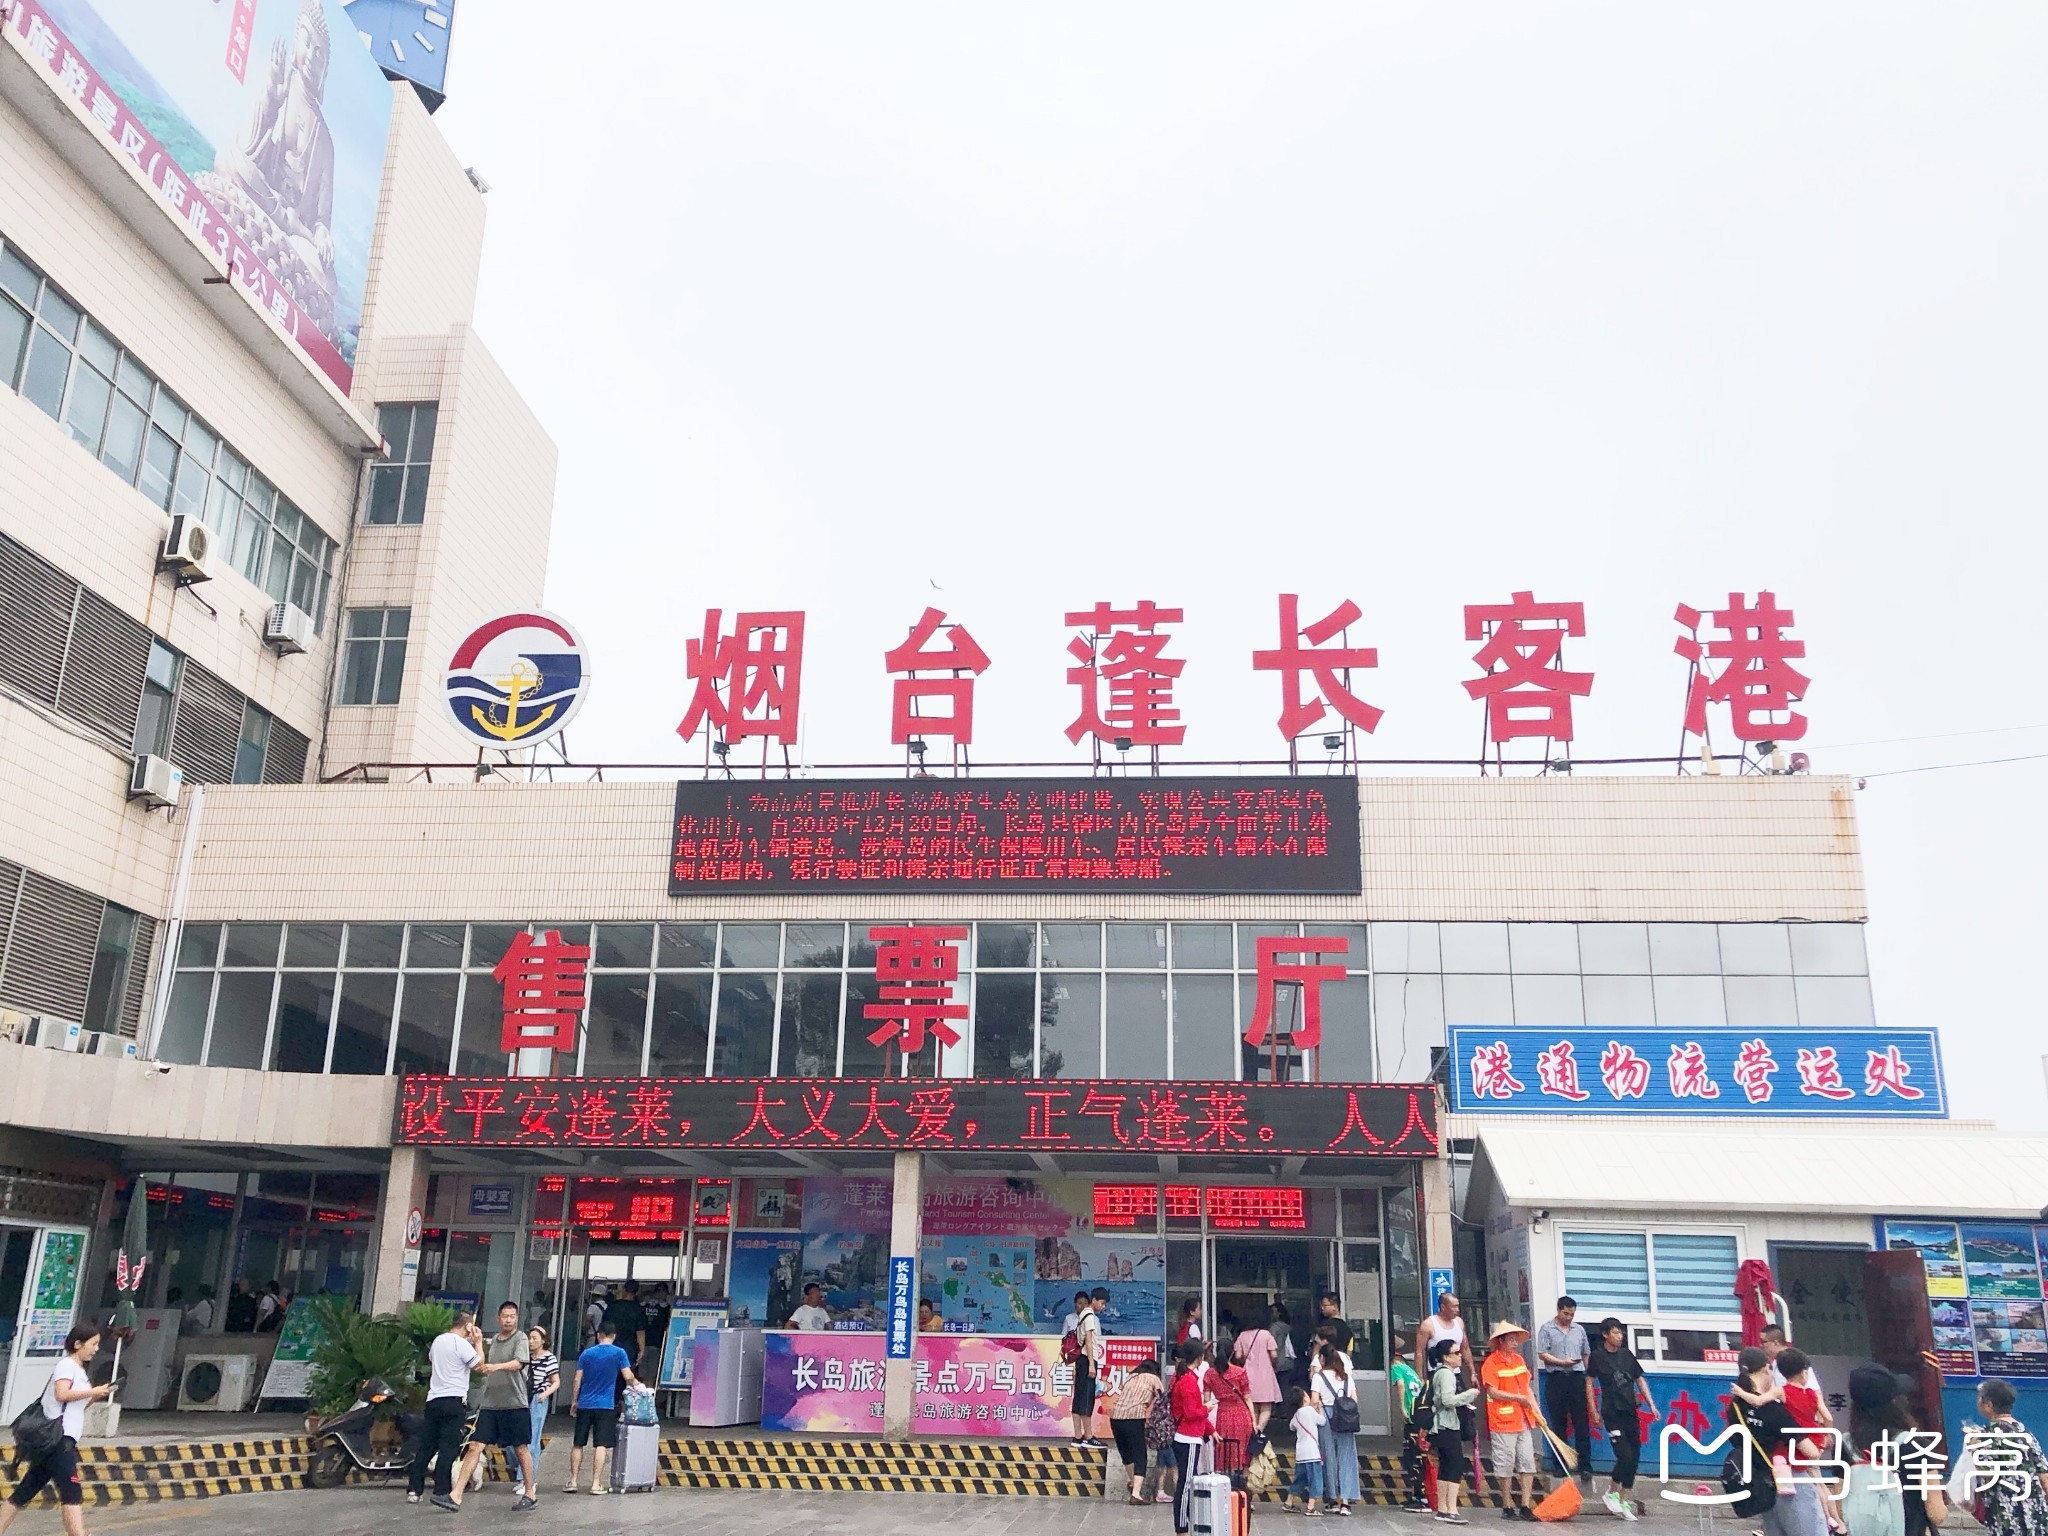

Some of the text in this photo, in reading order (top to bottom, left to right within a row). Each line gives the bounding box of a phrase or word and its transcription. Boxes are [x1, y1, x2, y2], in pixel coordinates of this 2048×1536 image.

[676, 590, 1811, 746] 烟台蓬长客港
[492, 926, 1349, 1053] 售票厅
[1471, 1038, 1925, 1104] 港通物流营运处
[943, 1209, 975, 1218] Tourism
[977, 1209, 1020, 1220] Consulting
[833, 1321, 865, 1331] 酒店预订
[892, 1261, 910, 1355] 长岛万鸟岛售票处
